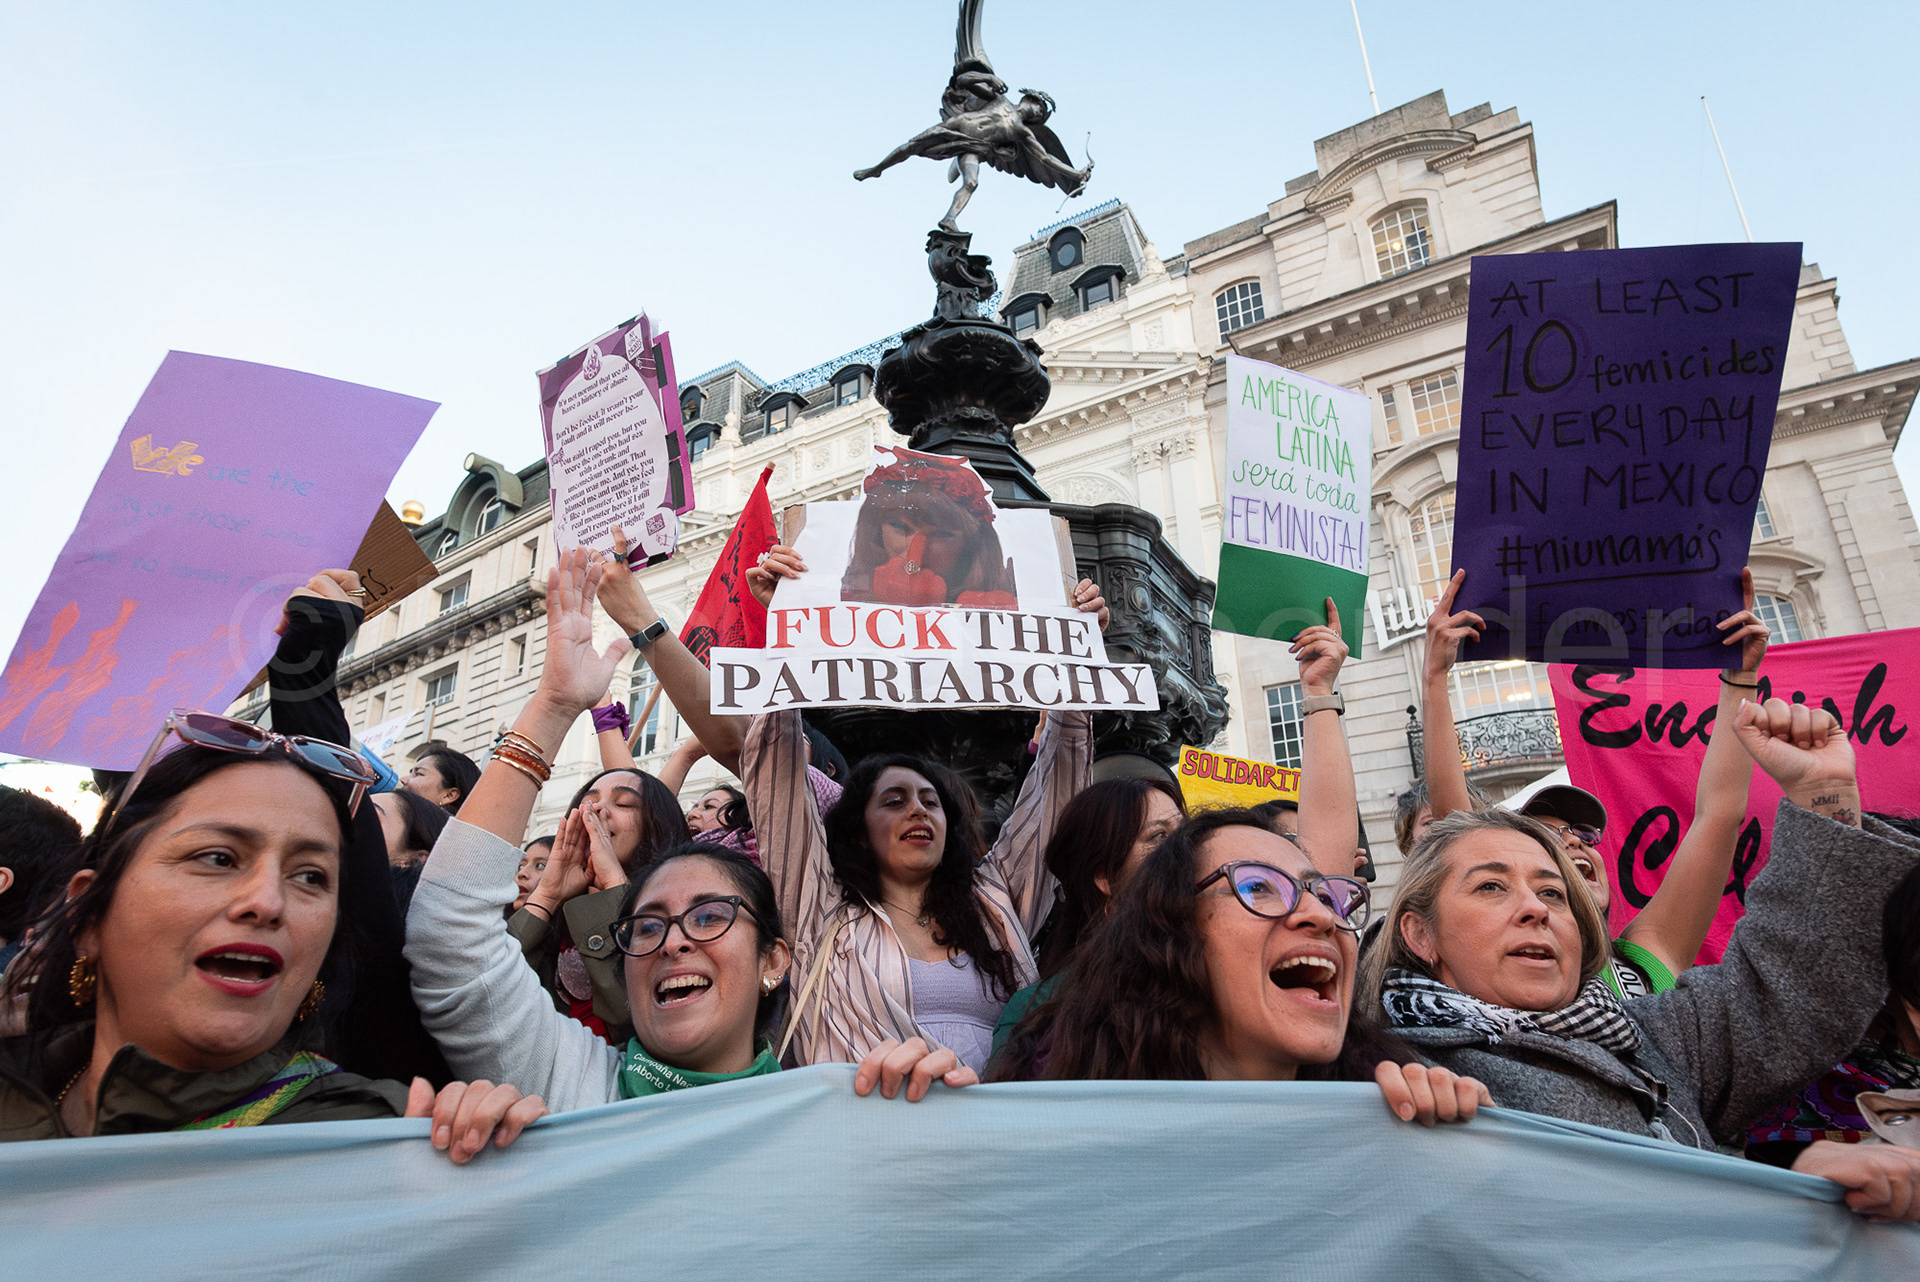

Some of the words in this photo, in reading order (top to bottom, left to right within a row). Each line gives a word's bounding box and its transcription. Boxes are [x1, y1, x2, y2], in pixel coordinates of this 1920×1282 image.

[1490, 279, 1556, 318] AT
[1594, 272, 1755, 318] LEAST
[1485, 319, 1577, 400] 10
[1587, 338, 1777, 395] femicides
[561, 403, 575, 414] have
[581, 389, 601, 404] history
[610, 375, 627, 388] abuse
[567, 392, 576, 402] not
[577, 380, 597, 397] normal
[598, 373, 610, 385] that
[629, 390, 644, 403] your
[1241, 374, 1340, 437] AMÉRICA
[560, 433, 575, 445] fault
[576, 427, 587, 438] and
[593, 418, 604, 429] will
[605, 411, 623, 423] never
[572, 448, 584, 460] said
[589, 437, 605, 451] raped
[621, 424, 632, 435] but
[634, 419, 646, 431] you
[130, 433, 204, 476] We
[208, 465, 251, 485] are
[268, 468, 314, 498] the
[564, 462, 580, 474] were
[581, 456, 590, 465] the
[591, 452, 602, 460] one
[603, 444, 617, 455] who
[618, 435, 630, 447] had
[631, 431, 643, 441] sex
[567, 471, 602, 492] unconscious
[629, 448, 646, 462] That
[579, 464, 591, 476] with
[597, 452, 616, 467] drunk
[617, 446, 629, 457] and
[1277, 422, 1356, 484] LATINA
[564, 490, 584, 504] woman
[585, 484, 598, 494] was
[612, 469, 625, 481] And
[640, 458, 653, 471] you
[565, 497, 585, 513] blamed
[598, 486, 609, 498] and
[611, 480, 628, 492] made
[641, 466, 654, 478] feel
[569, 510, 580, 519] like
[615, 489, 631, 499] Who
[639, 480, 649, 489] the
[1233, 459, 1298, 494] será
[1306, 474, 1361, 514] toda
[1490, 467, 1549, 515] IN
[1584, 462, 1761, 511] MEXICO
[571, 518, 583, 529] real
[584, 508, 610, 523] monster
[611, 501, 626, 511] here
[637, 488, 649, 500] still
[578, 526, 608, 544] happened
[624, 511, 644, 526] night?
[592, 511, 626, 530] remember
[627, 502, 644, 515] what
[1231, 494, 1364, 570] FEMINISTA!
[770, 606, 957, 651] FUCK
[965, 610, 1093, 659] THE
[717, 657, 1146, 709] PATRIARCHY
[1181, 749, 1301, 792] SOLIDARIT
[633, 1052, 673, 1079] Campaña
[633, 1064, 664, 1089] Aborto
